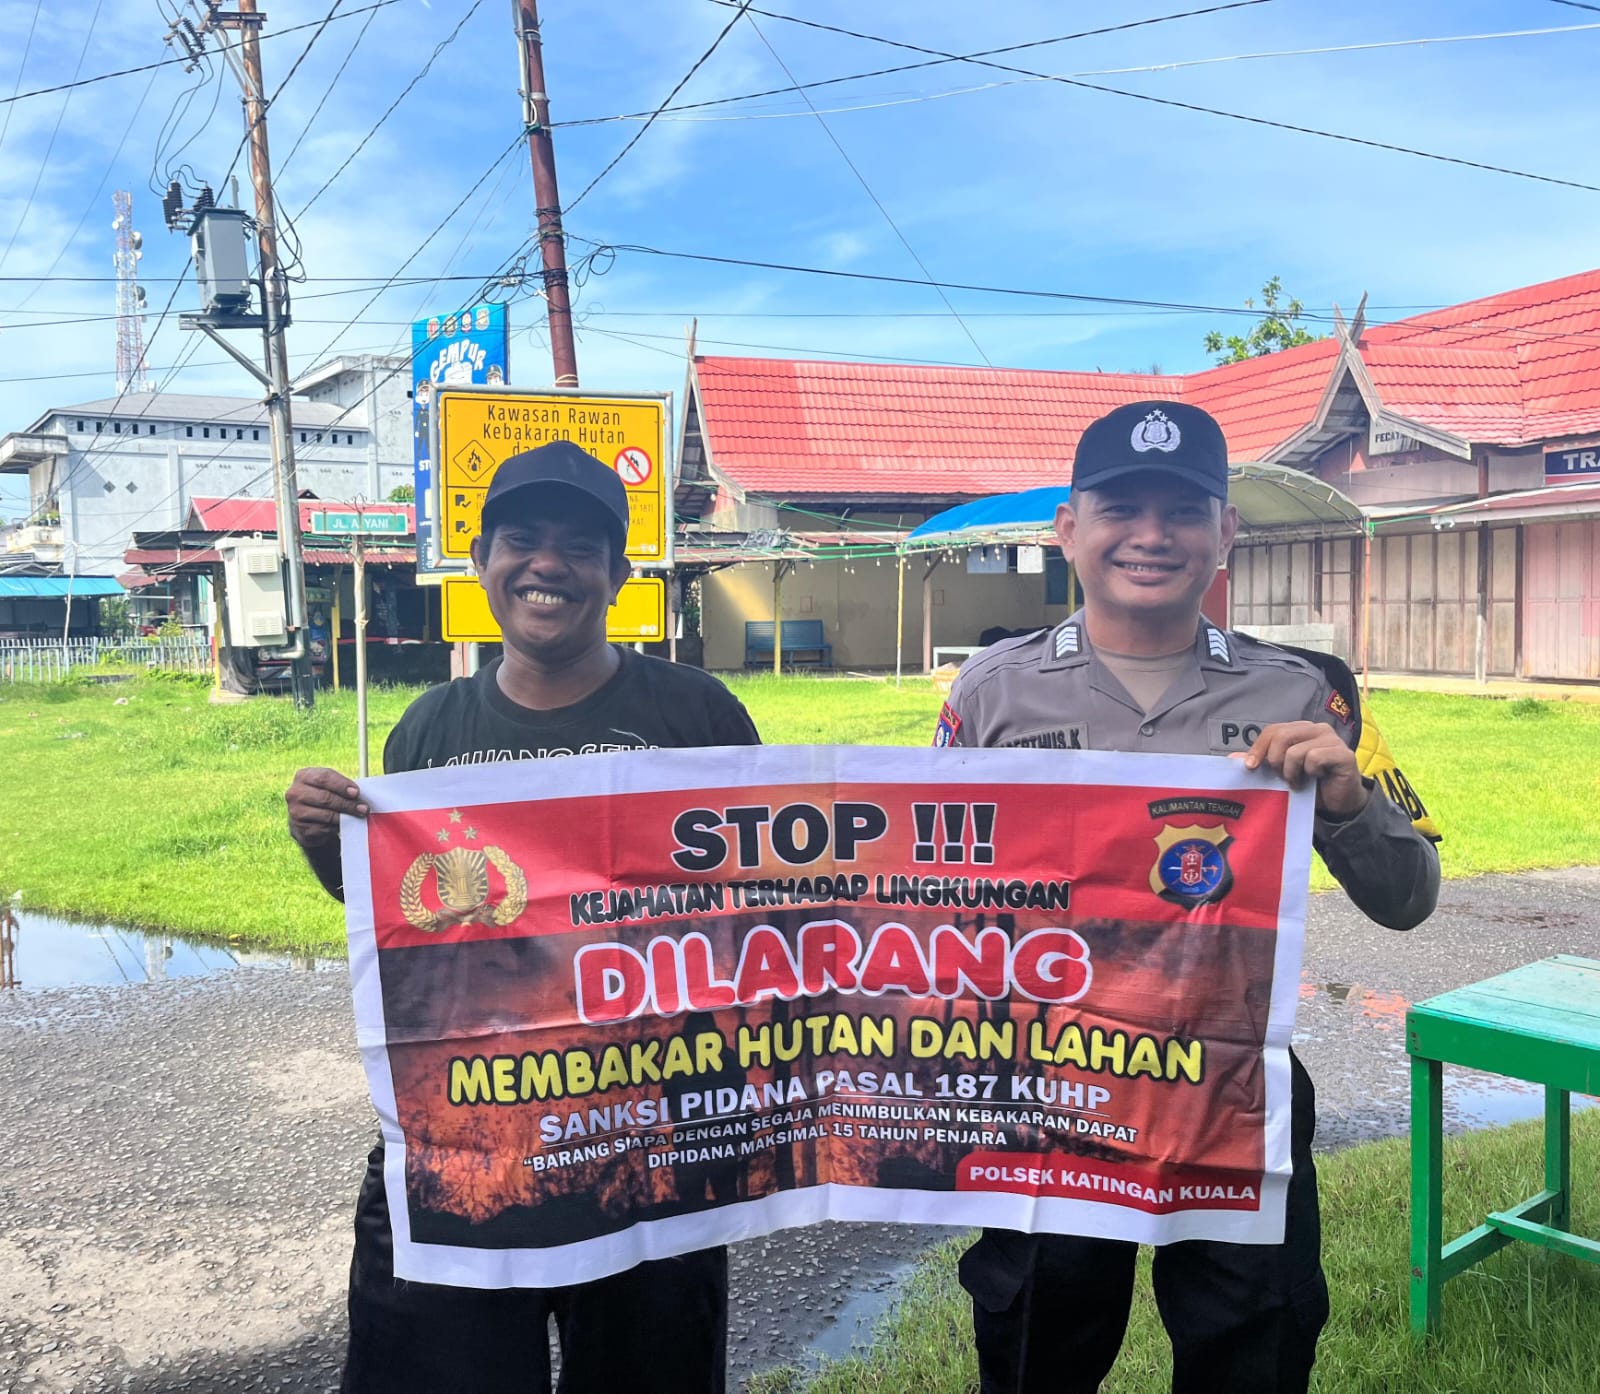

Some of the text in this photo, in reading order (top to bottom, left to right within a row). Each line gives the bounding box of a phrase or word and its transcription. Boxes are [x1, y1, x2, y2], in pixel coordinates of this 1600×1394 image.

[430, 339, 486, 383] GEMPUR
[483, 423, 625, 444] Kebakaran Hutan
[487, 404, 621, 426] Kawasan Rawan
[1562, 451, 1600, 470] TR
[364, 518, 389, 529] YANI
[1151, 801, 1240, 817] KALIMANTAN TENGAH
[671, 802, 997, 872] STOP !!!
[569, 873, 1071, 927] KEJAHATAN TERHADAP LINGKUNGAN
[573, 918, 1094, 1026] DILARANG
[448, 1013, 1204, 1105] MEMBAKAR HUTAN DAN LAHAN
[539, 1069, 1112, 1143] SANKSI PIDANA PASAL 187 KUHP
[614, 1133, 668, 1153] SIAPA
[672, 1121, 747, 1144] DENGAN
[751, 1107, 813, 1132] SEGAJA
[817, 1102, 951, 1122] MENIMBULKAN
[955, 1107, 1072, 1131] KEBAKARAN
[1076, 1118, 1137, 1143] DAPAT
[647, 1122, 1007, 1169] DIPIDANA MAKSIMAL 15 TAHUN PENJARA
[970, 1166, 1256, 1204] POLSEK KATINGAN KUALA
